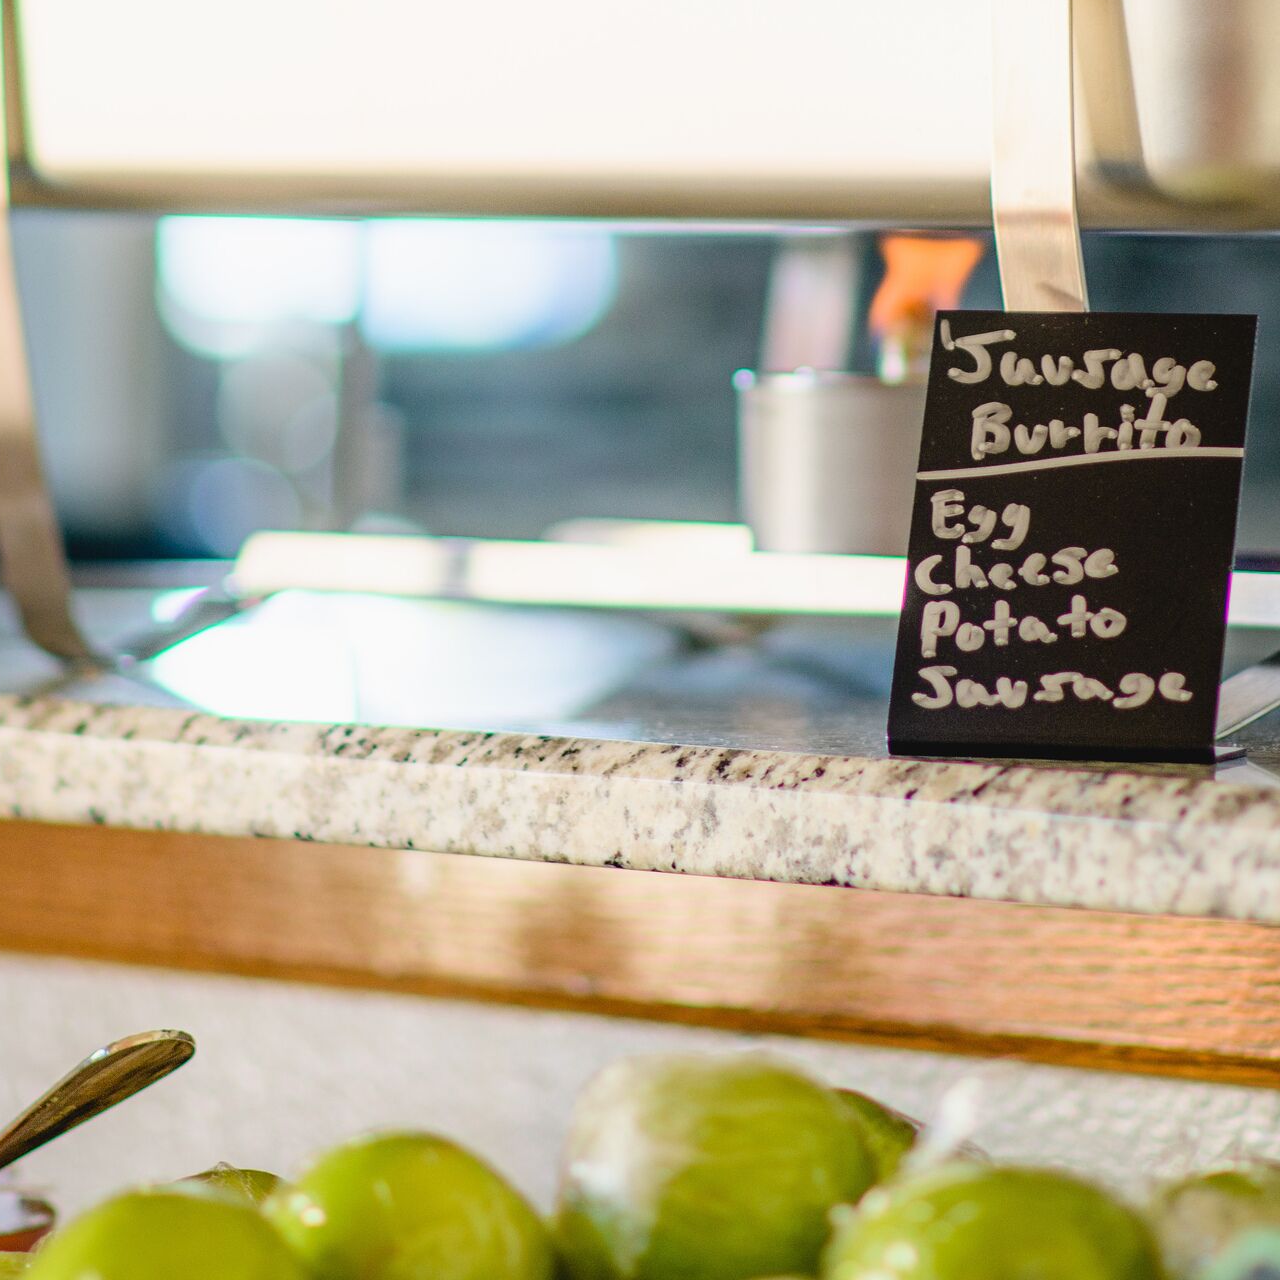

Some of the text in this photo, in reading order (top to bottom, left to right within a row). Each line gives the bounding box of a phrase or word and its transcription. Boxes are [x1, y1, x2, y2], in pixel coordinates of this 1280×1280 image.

[940, 320, 1219, 398] Sausage
[970, 392, 1202, 460] Burrito
[930, 488, 1031, 550] Egg
[911, 664, 1194, 710] Sausage
